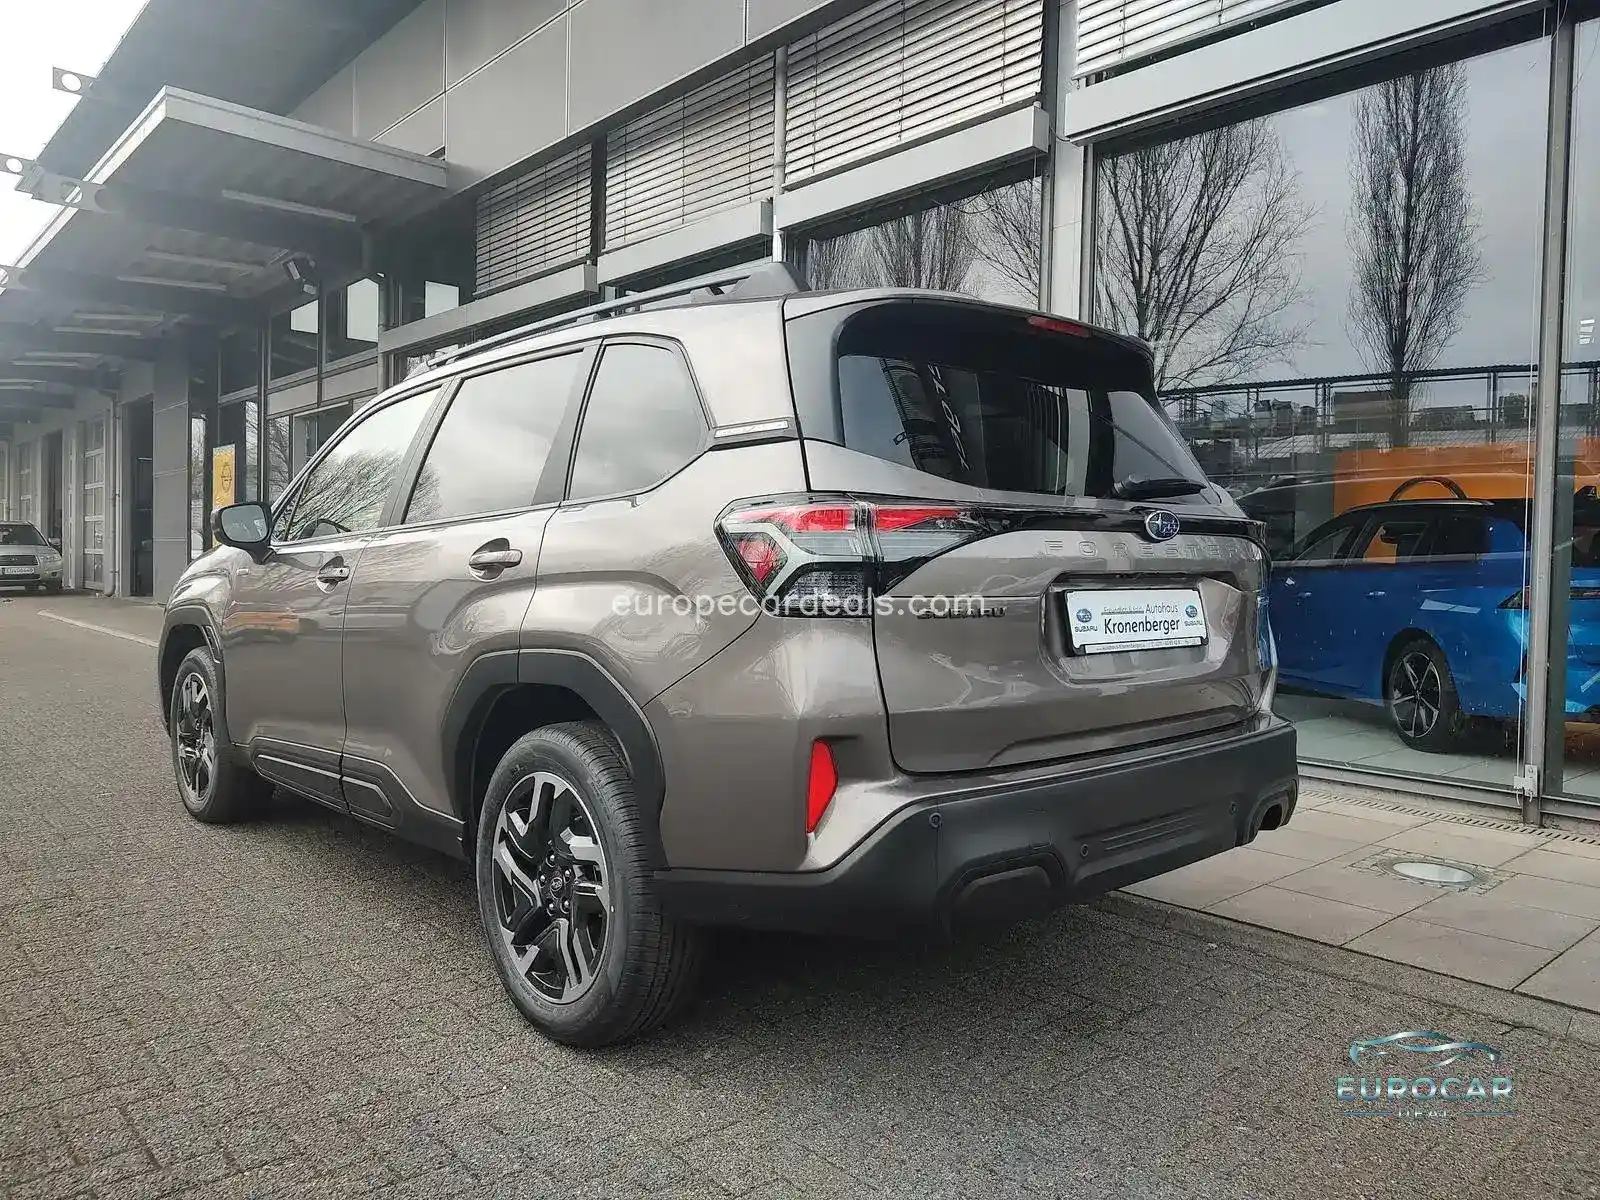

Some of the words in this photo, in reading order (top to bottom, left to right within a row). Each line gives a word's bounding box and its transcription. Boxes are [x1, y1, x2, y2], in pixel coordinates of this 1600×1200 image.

[1145, 601, 1179, 614] Autohaus
[1074, 625, 1098, 633] SUBARU
[1104, 615, 1180, 635] Kronenberger
